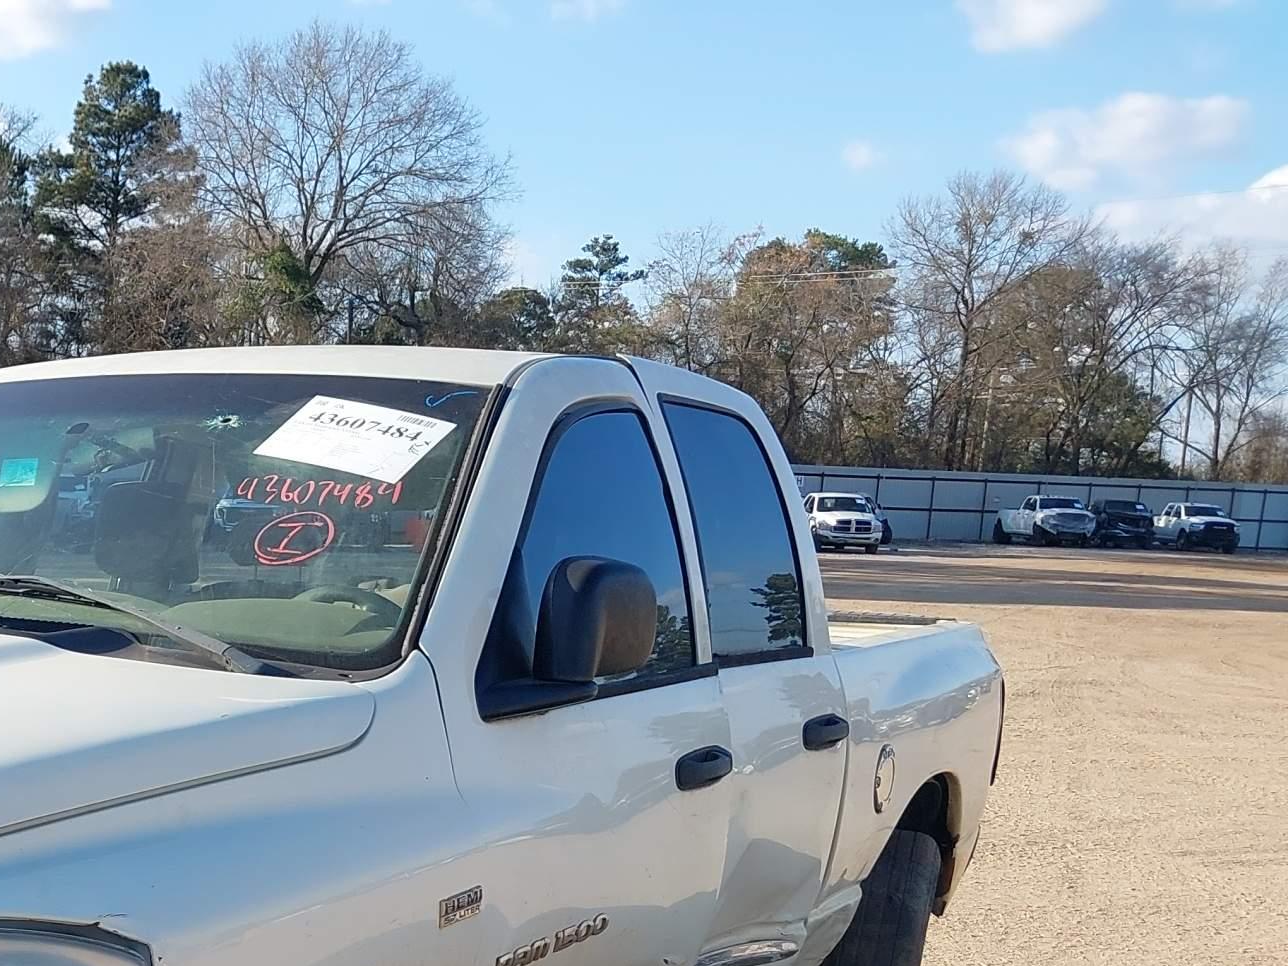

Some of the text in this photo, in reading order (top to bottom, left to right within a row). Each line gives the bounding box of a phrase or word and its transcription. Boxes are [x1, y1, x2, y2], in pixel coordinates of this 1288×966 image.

[309, 411, 423, 442] 43607484
[237, 475, 404, 508] 43607484
[444, 888, 483, 916] HEMI
[458, 904, 481, 919] LITER
[551, 912, 610, 953] 1500
